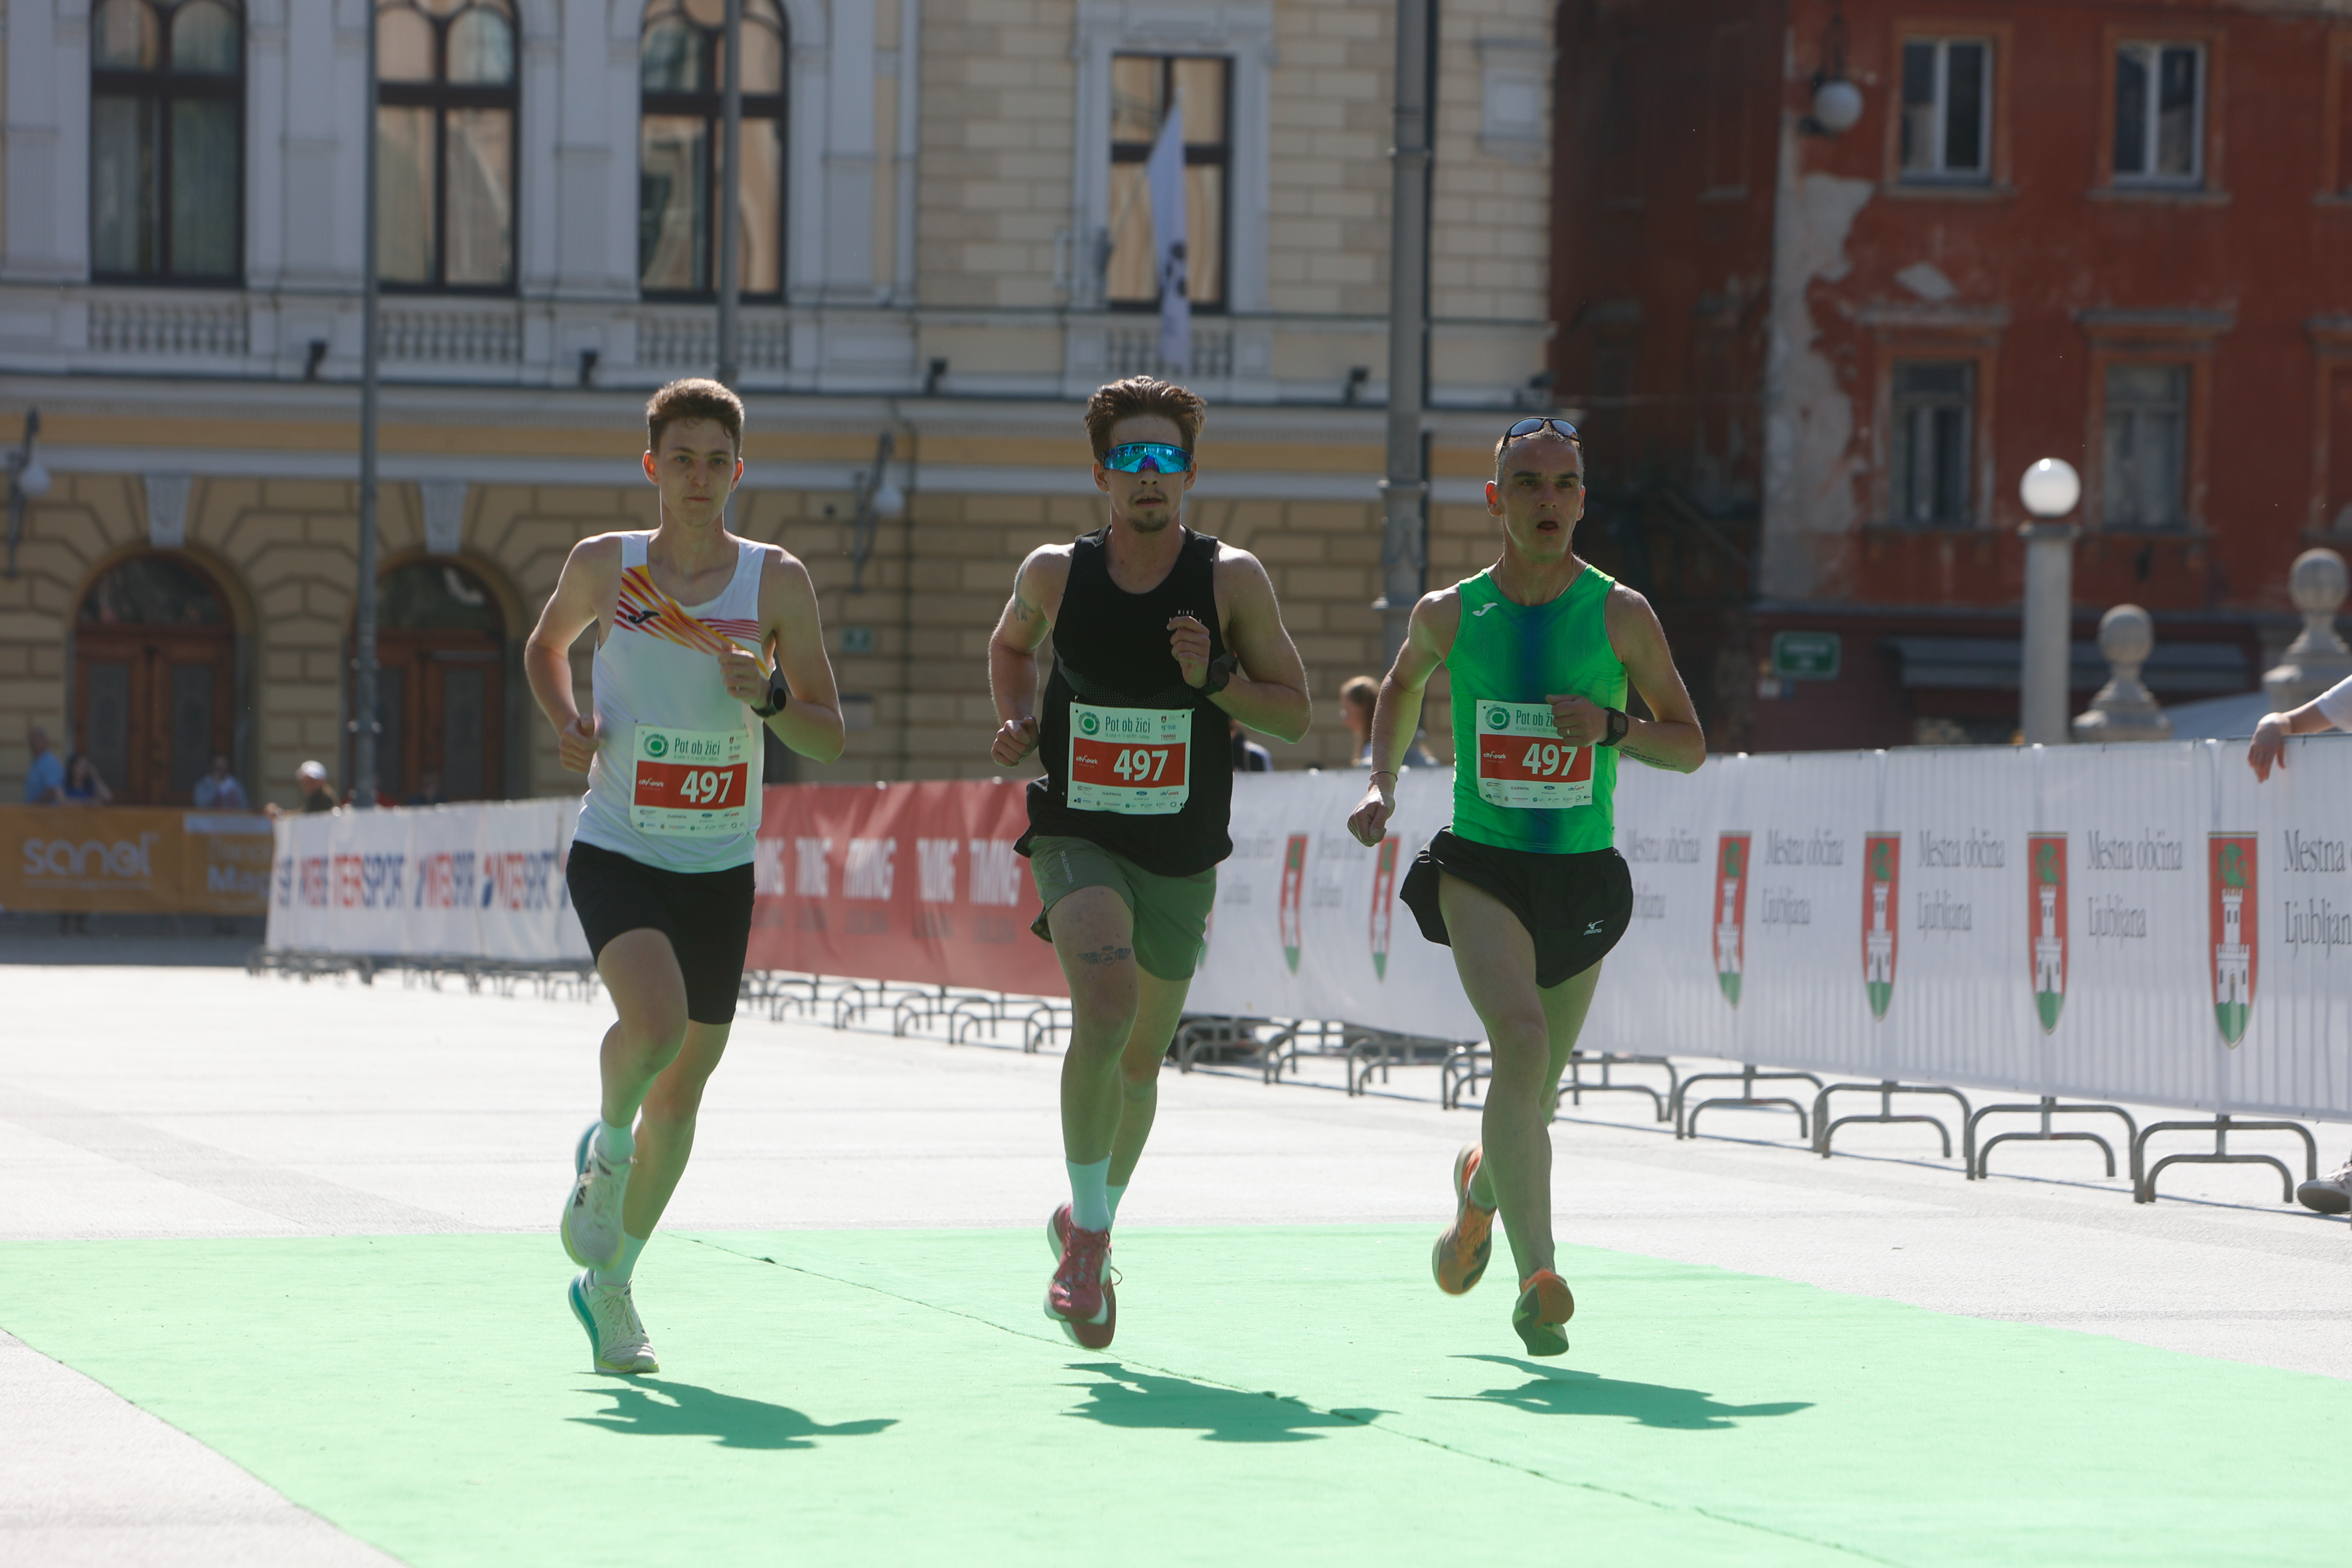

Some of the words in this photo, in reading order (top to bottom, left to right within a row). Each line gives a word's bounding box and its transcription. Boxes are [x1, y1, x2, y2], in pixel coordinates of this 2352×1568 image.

[1106, 716, 1119, 732] Pot
[1122, 717, 1133, 732] ob
[1135, 717, 1150, 733] žici
[1516, 710, 1530, 725] Pot
[1533, 712, 1543, 726] ob
[674, 737, 688, 753] Pot
[691, 740, 702, 755] ob
[704, 740, 720, 755] žici
[1522, 744, 1578, 776] 497
[1113, 749, 1168, 781] 497
[680, 771, 734, 804] 497
[1918, 829, 1961, 868] Mestna
[2086, 829, 2134, 871] Mestna
[2136, 826, 2183, 872] občina
[2284, 829, 2346, 872] Mestna
[1059, 850, 1073, 884] SALOMON
[1917, 890, 1972, 944] Ljubljana
[2088, 894, 2148, 951] Ljubljana
